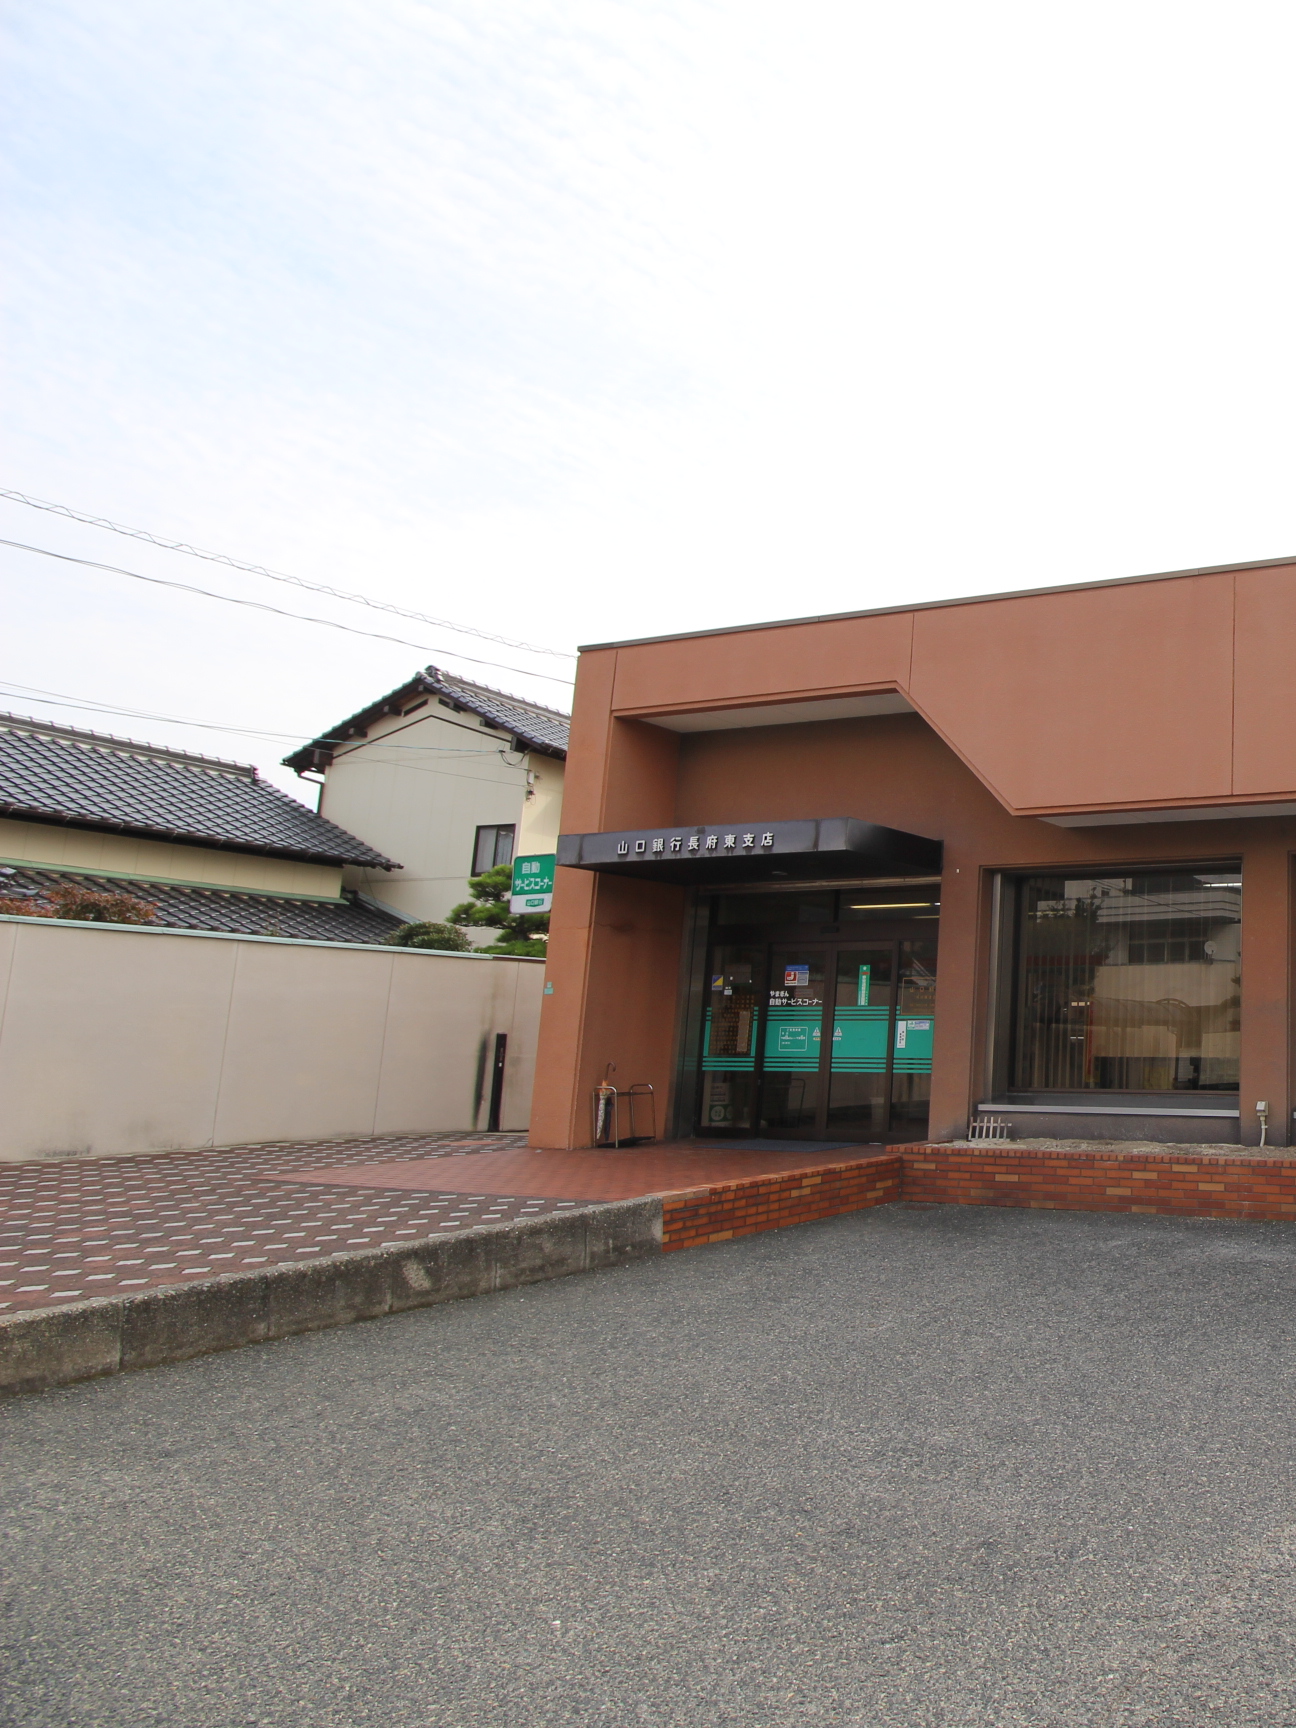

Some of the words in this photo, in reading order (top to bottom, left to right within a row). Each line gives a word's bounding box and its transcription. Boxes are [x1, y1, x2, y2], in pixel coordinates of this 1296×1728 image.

[617, 832, 774, 855] 山口銀行長府東支店
[522, 861, 541, 874] 自動
[515, 876, 552, 891] サービスコーナー
[769, 998, 823, 1006] 自動サービスコーナー
